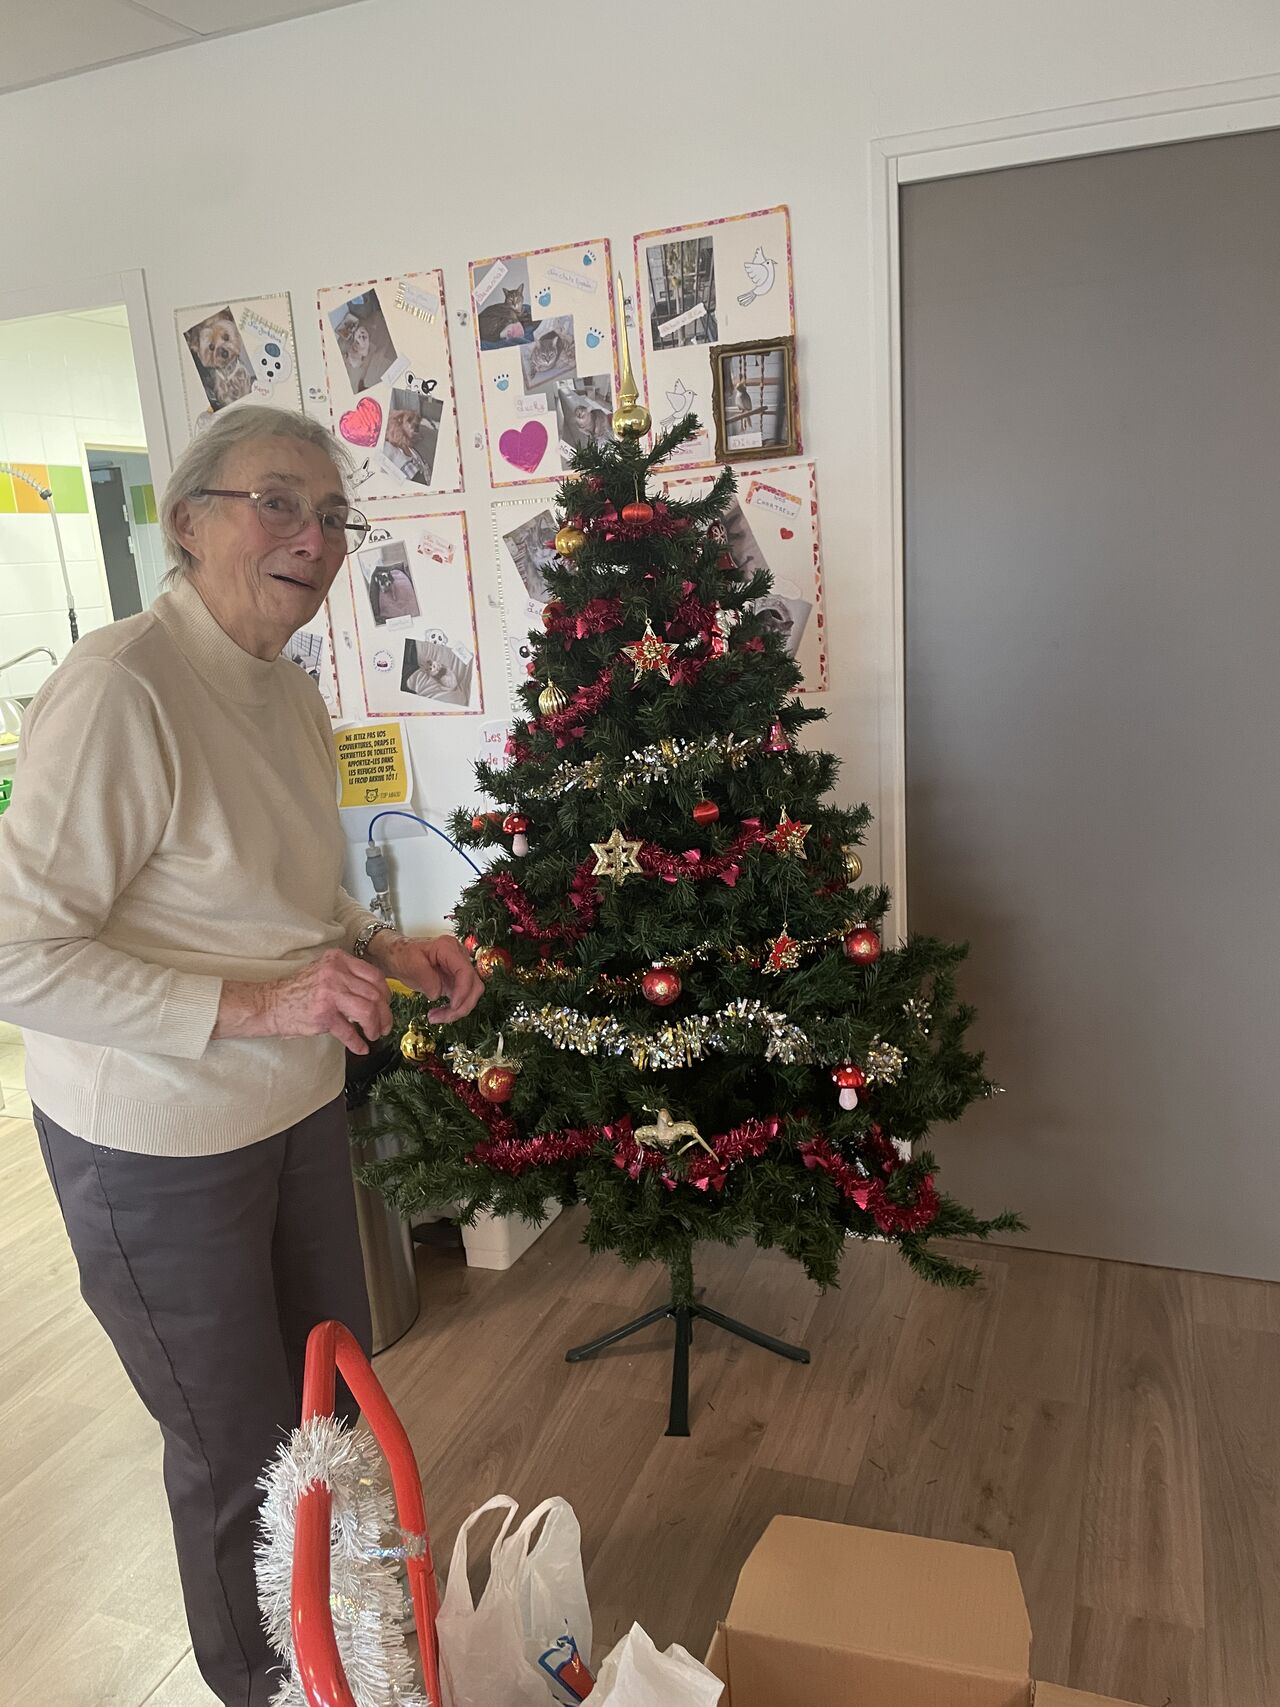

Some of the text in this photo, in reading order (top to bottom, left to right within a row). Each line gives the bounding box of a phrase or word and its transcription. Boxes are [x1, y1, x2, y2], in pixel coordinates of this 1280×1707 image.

[345, 730, 386, 742] NE JETEZ PAS VOS
[484, 730, 501, 742] Les
[339, 741, 373, 751] COUVERTURES,
[374, 739, 389, 747] DRAPS
[340, 750, 366, 760] SERVIETTES
[486, 753, 498, 765] de
[348, 756, 394, 767] APPORTEZ-LES DANS
[348, 768, 356, 776] LES
[357, 766, 377, 775] REFUGES
[355, 776, 369, 784] FROID
[369, 774, 385, 783] ARRIVE
